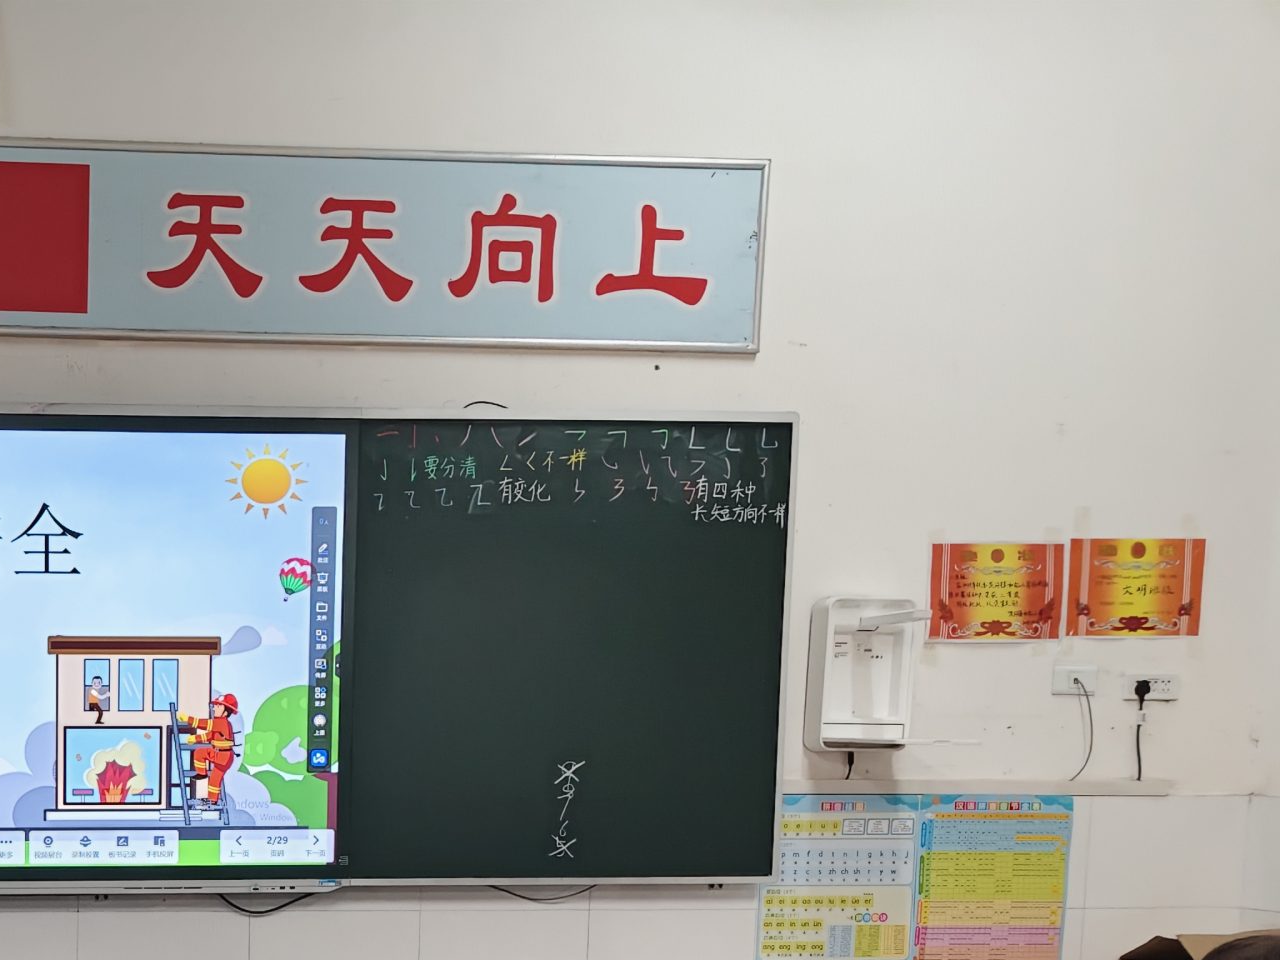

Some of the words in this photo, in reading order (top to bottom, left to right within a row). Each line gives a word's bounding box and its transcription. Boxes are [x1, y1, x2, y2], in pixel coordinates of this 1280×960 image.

[145, 191, 709, 307] 天天向上
[423, 455, 477, 480] 要分清
[498, 476, 551, 504] 有变化
[695, 475, 757, 503] 有四种
[690, 503, 787, 529] 长短方向不一样
[266, 836, 289, 845] 2/29
